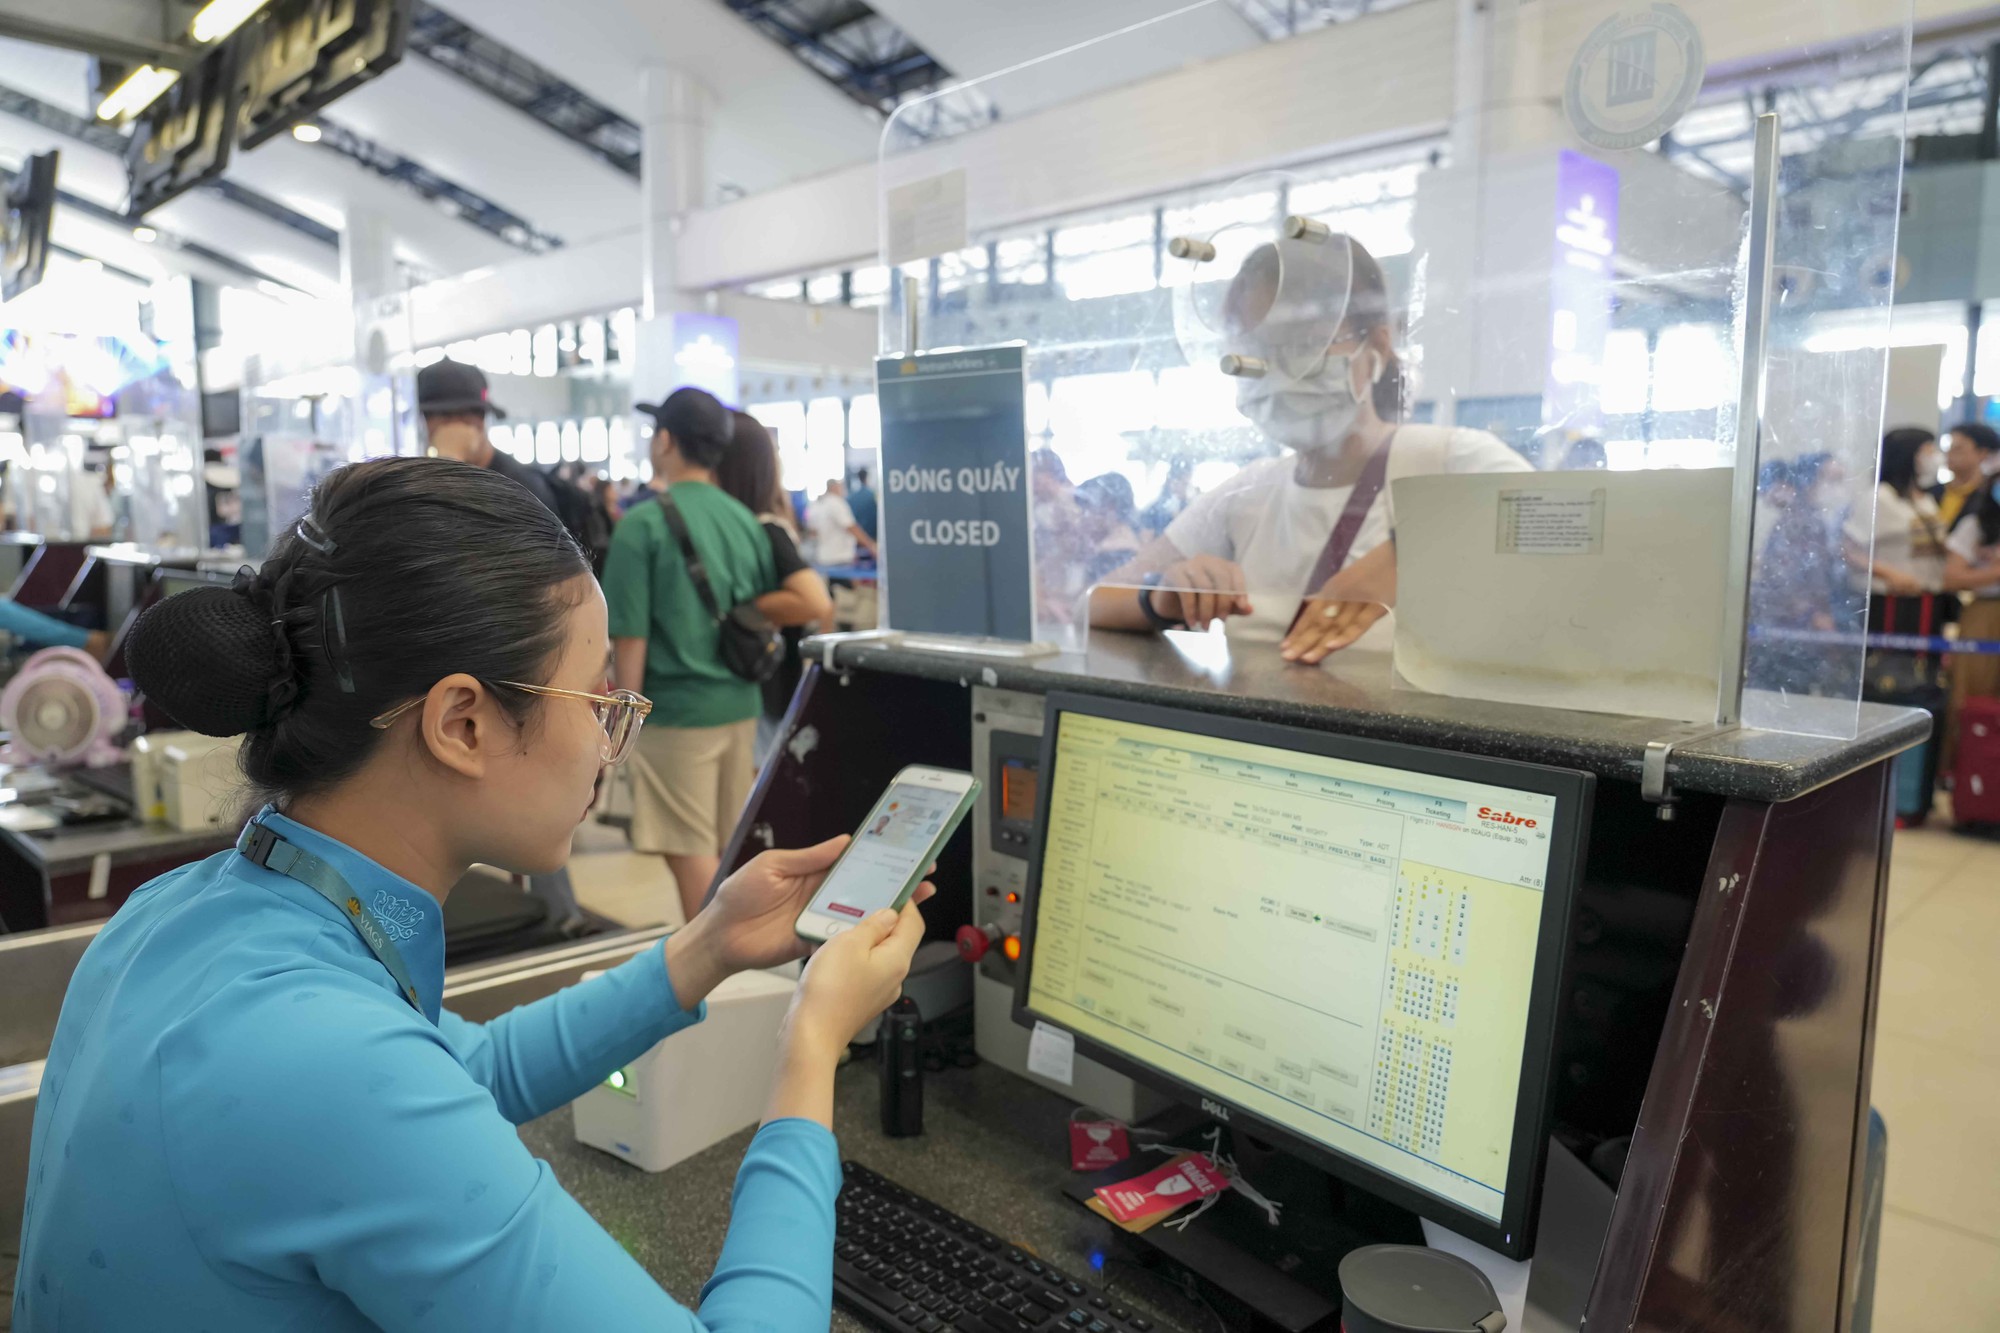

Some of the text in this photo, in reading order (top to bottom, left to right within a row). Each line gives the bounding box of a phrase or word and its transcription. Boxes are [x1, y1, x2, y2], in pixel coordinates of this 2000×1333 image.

[888, 464, 952, 493] ĐÓNG
[910, 519, 1001, 546] CLOSED
[1425, 807, 1451, 819] Ticketing
[1476, 806, 1537, 828] Sabre
[1481, 820, 1518, 834] RES-HAN-5
[1520, 875, 1532, 884] Attr
[361, 914, 384, 948] VIAGS
[1202, 1098, 1230, 1122] DELL
[1178, 1160, 1216, 1194] FRAGILE
